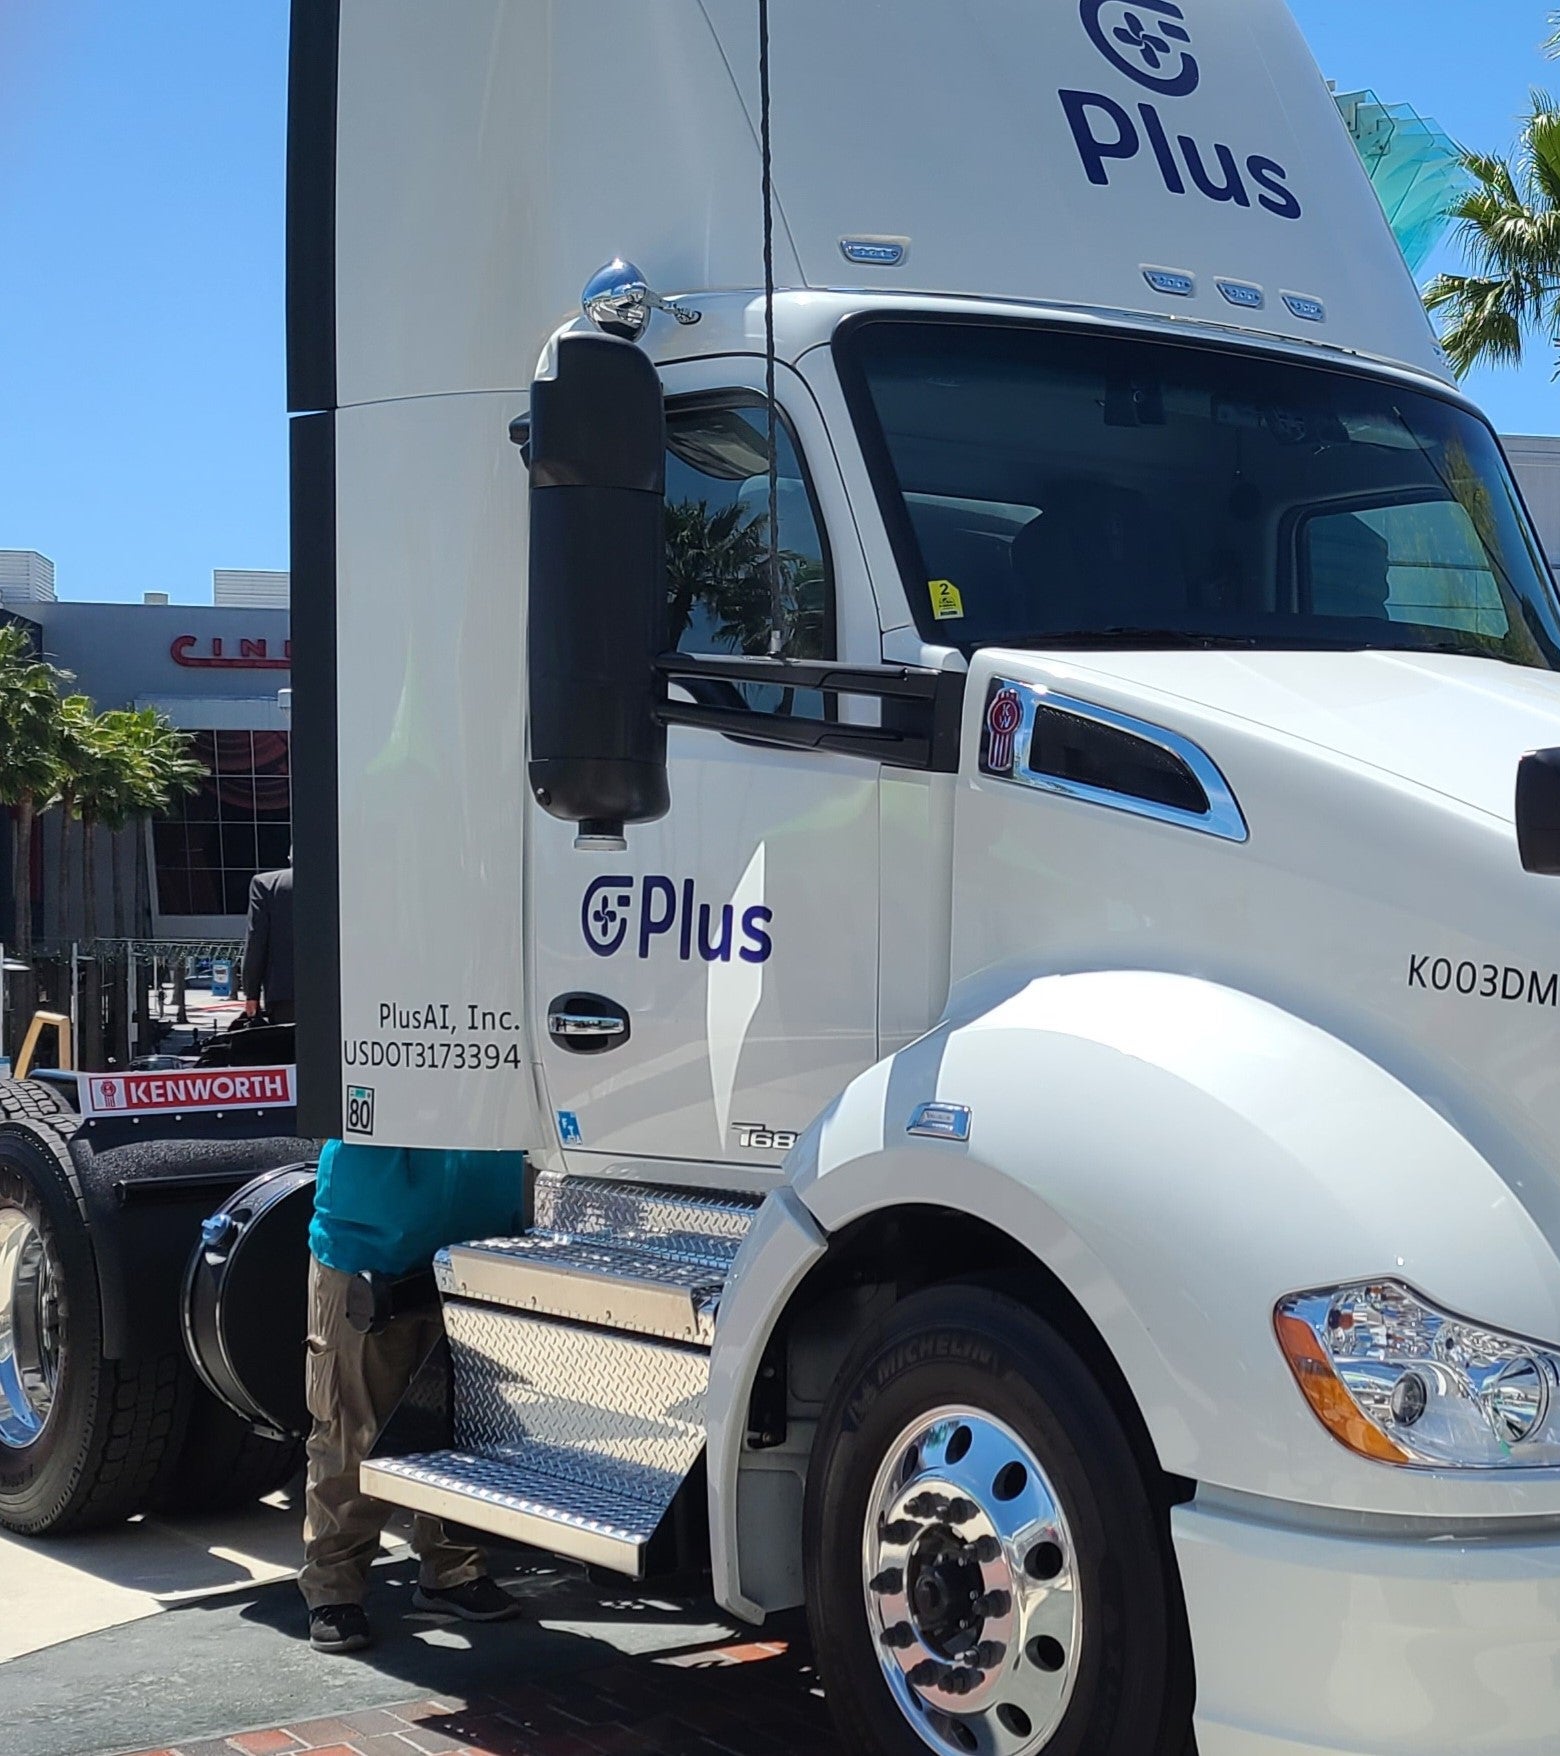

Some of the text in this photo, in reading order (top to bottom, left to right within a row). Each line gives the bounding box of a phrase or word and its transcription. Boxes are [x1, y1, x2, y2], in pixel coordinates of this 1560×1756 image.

[1057, 88, 1302, 220] Plus
[939, 583, 951, 595] 2
[638, 875, 773, 964] Plus
[1408, 953, 1559, 1007] K003DM
[379, 1002, 521, 1035] PlusAI, Inc.
[344, 1040, 522, 1070] USDOT3173394
[130, 1075, 283, 1104] KENWORTH
[349, 1098, 371, 1129] 80
[732, 1122, 801, 1149] T68
